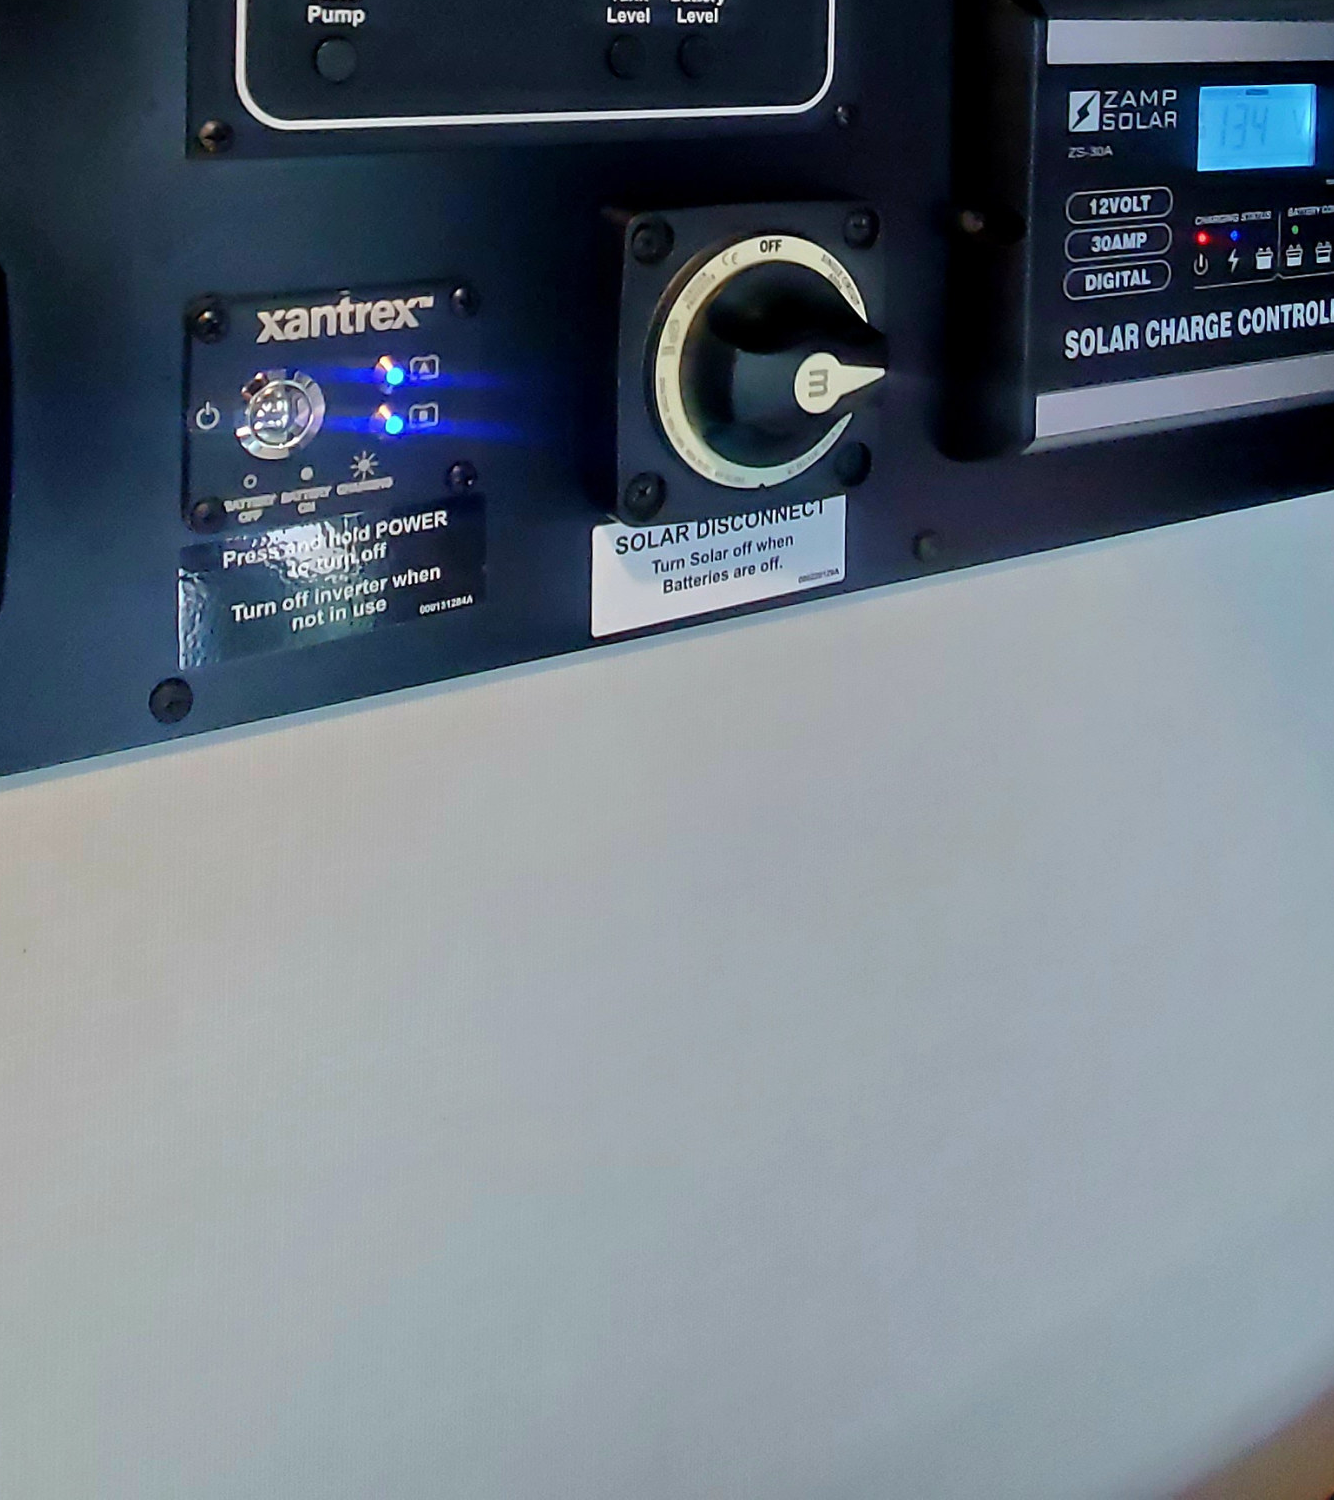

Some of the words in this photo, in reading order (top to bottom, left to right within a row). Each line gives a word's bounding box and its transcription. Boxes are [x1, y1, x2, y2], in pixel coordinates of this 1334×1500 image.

[307, 4, 366, 28] Pump
[606, 6, 651, 24] Level
[676, 6, 719, 24] Level
[1102, 89, 1177, 108] ZAMP
[1102, 110, 1177, 131] SOLAR
[1067, 145, 1114, 159] ZS-30A
[758, 238, 783, 254] OFF
[1084, 268, 1152, 292] DIGITAL
[1064, 322, 1140, 360] SOLAR
[1145, 311, 1233, 349] CHARGE
[222, 546, 279, 570] Press
[285, 536, 327, 559] and
[329, 522, 371, 548] hold
[375, 509, 449, 540] POWER
[615, 524, 690, 556] SOLAR
[695, 499, 825, 541] DISCONNECT
[360, 541, 387, 563] off
[651, 556, 686, 575] Turn
[690, 547, 729, 568] Solar
[732, 540, 753, 558] off
[756, 534, 794, 553] when
[662, 567, 730, 595] Batteries
[732, 561, 757, 579] are
[760, 556, 784, 574] off.
[231, 600, 277, 623] Turn
[281, 590, 310, 612] off
[392, 565, 442, 590] when
[291, 608, 325, 633] not
[329, 605, 347, 622] in
[352, 597, 388, 618] use
